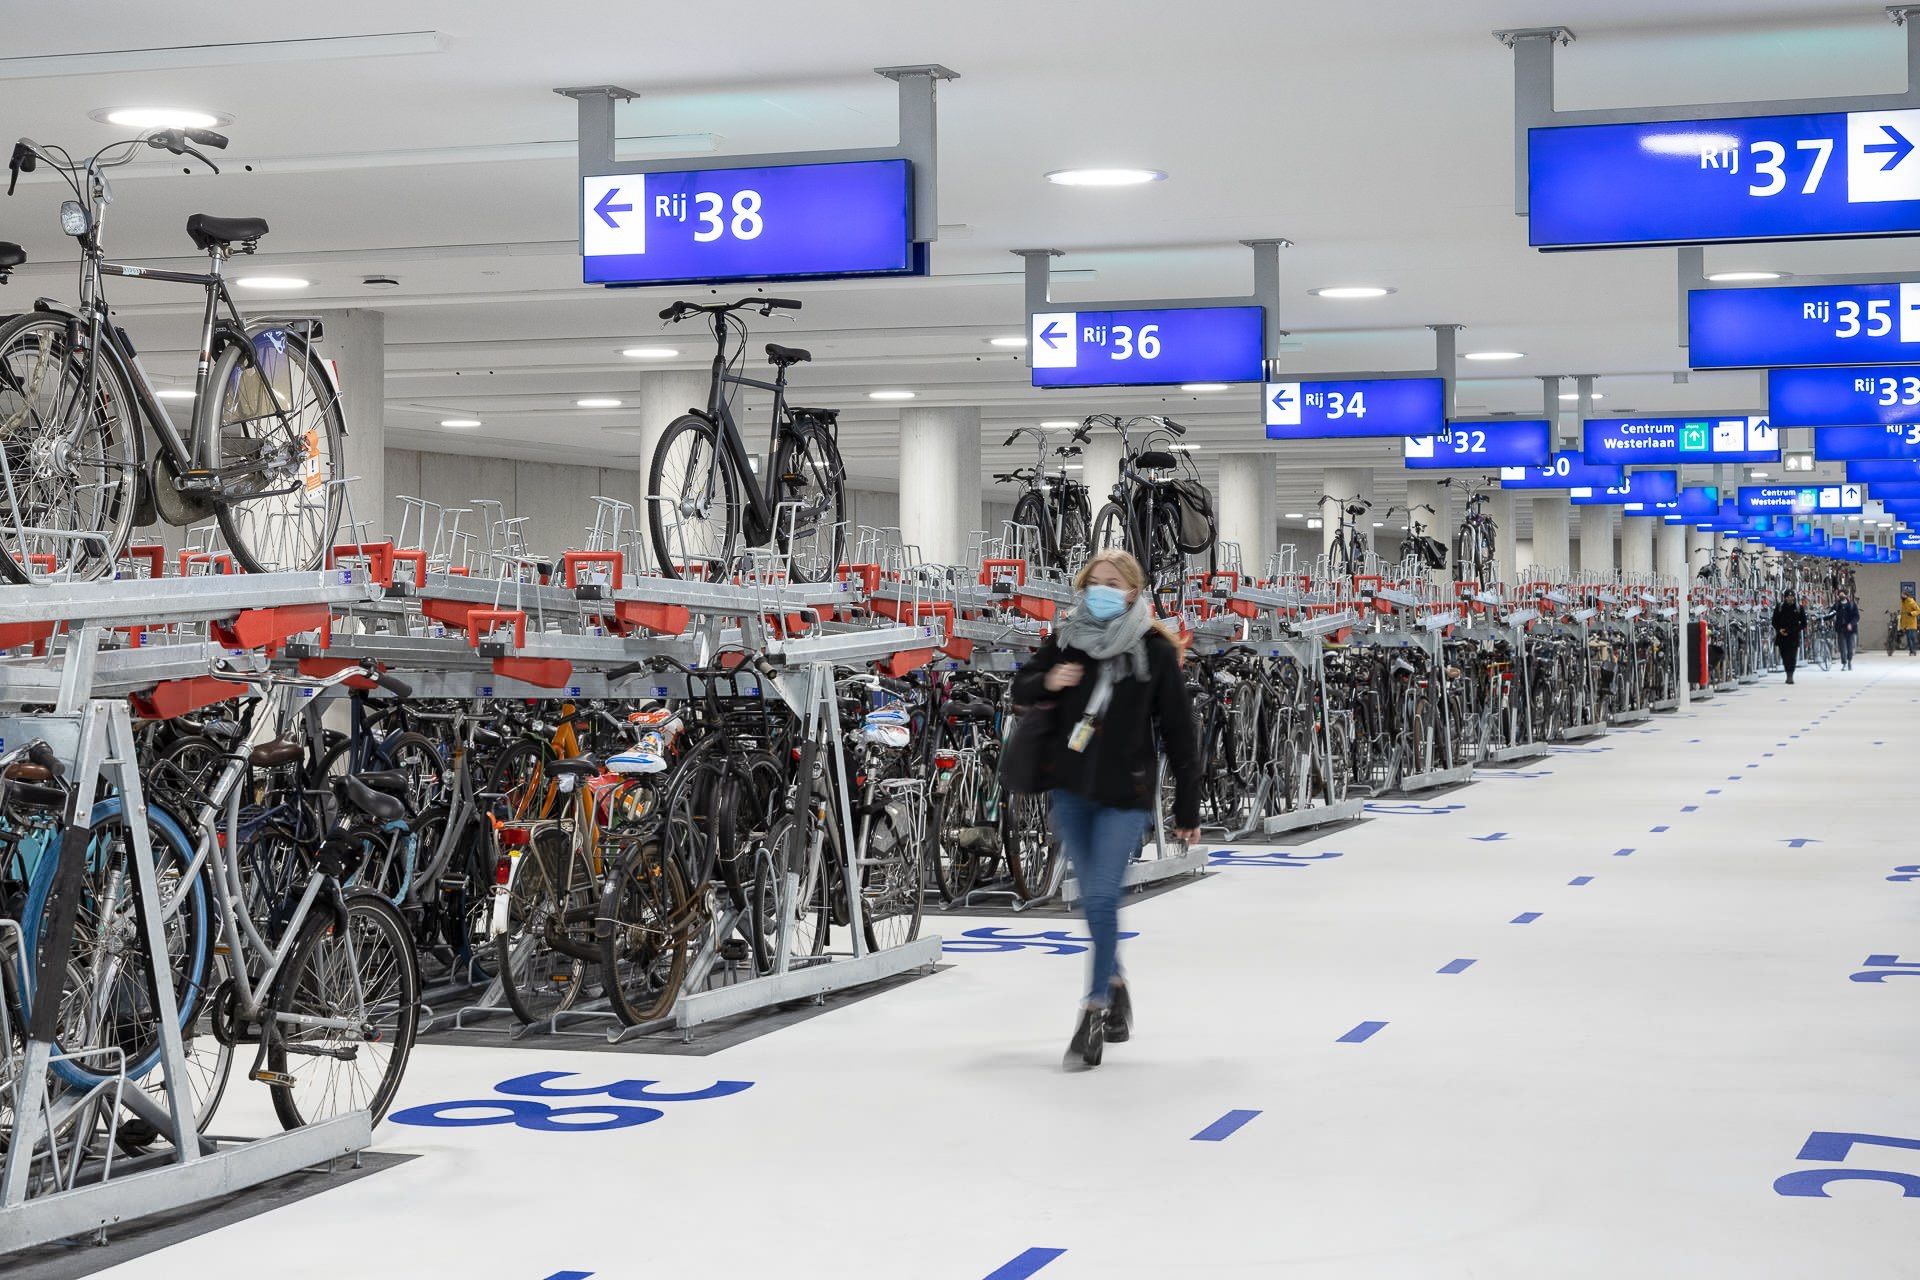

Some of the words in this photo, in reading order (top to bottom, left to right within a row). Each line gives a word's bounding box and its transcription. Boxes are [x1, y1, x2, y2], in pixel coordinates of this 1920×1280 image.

[1700, 144, 1739, 174] Rij
[1749, 138, 1834, 197] 37
[655, 193, 688, 222] Rij
[693, 189, 764, 243] 38
[1803, 301, 1829, 323] Rij
[1835, 299, 1893, 339] 35
[1083, 325, 1107, 345] Rij
[1110, 324, 1161, 361] 36
[1305, 393, 1323, 408] Rij
[1326, 391, 1367, 420] 34
[1854, 378, 1875, 395] Rij
[1878, 377, 1920, 406] 33
[1454, 431, 1486, 453] 32
[1620, 423, 1675, 434] Centrum
[1603, 438, 1675, 449] Westerlaan
[1750, 498, 1796, 506] Westerlaan
[1761, 489, 1796, 497] Centrum
[387, 1071, 756, 1132] 38
